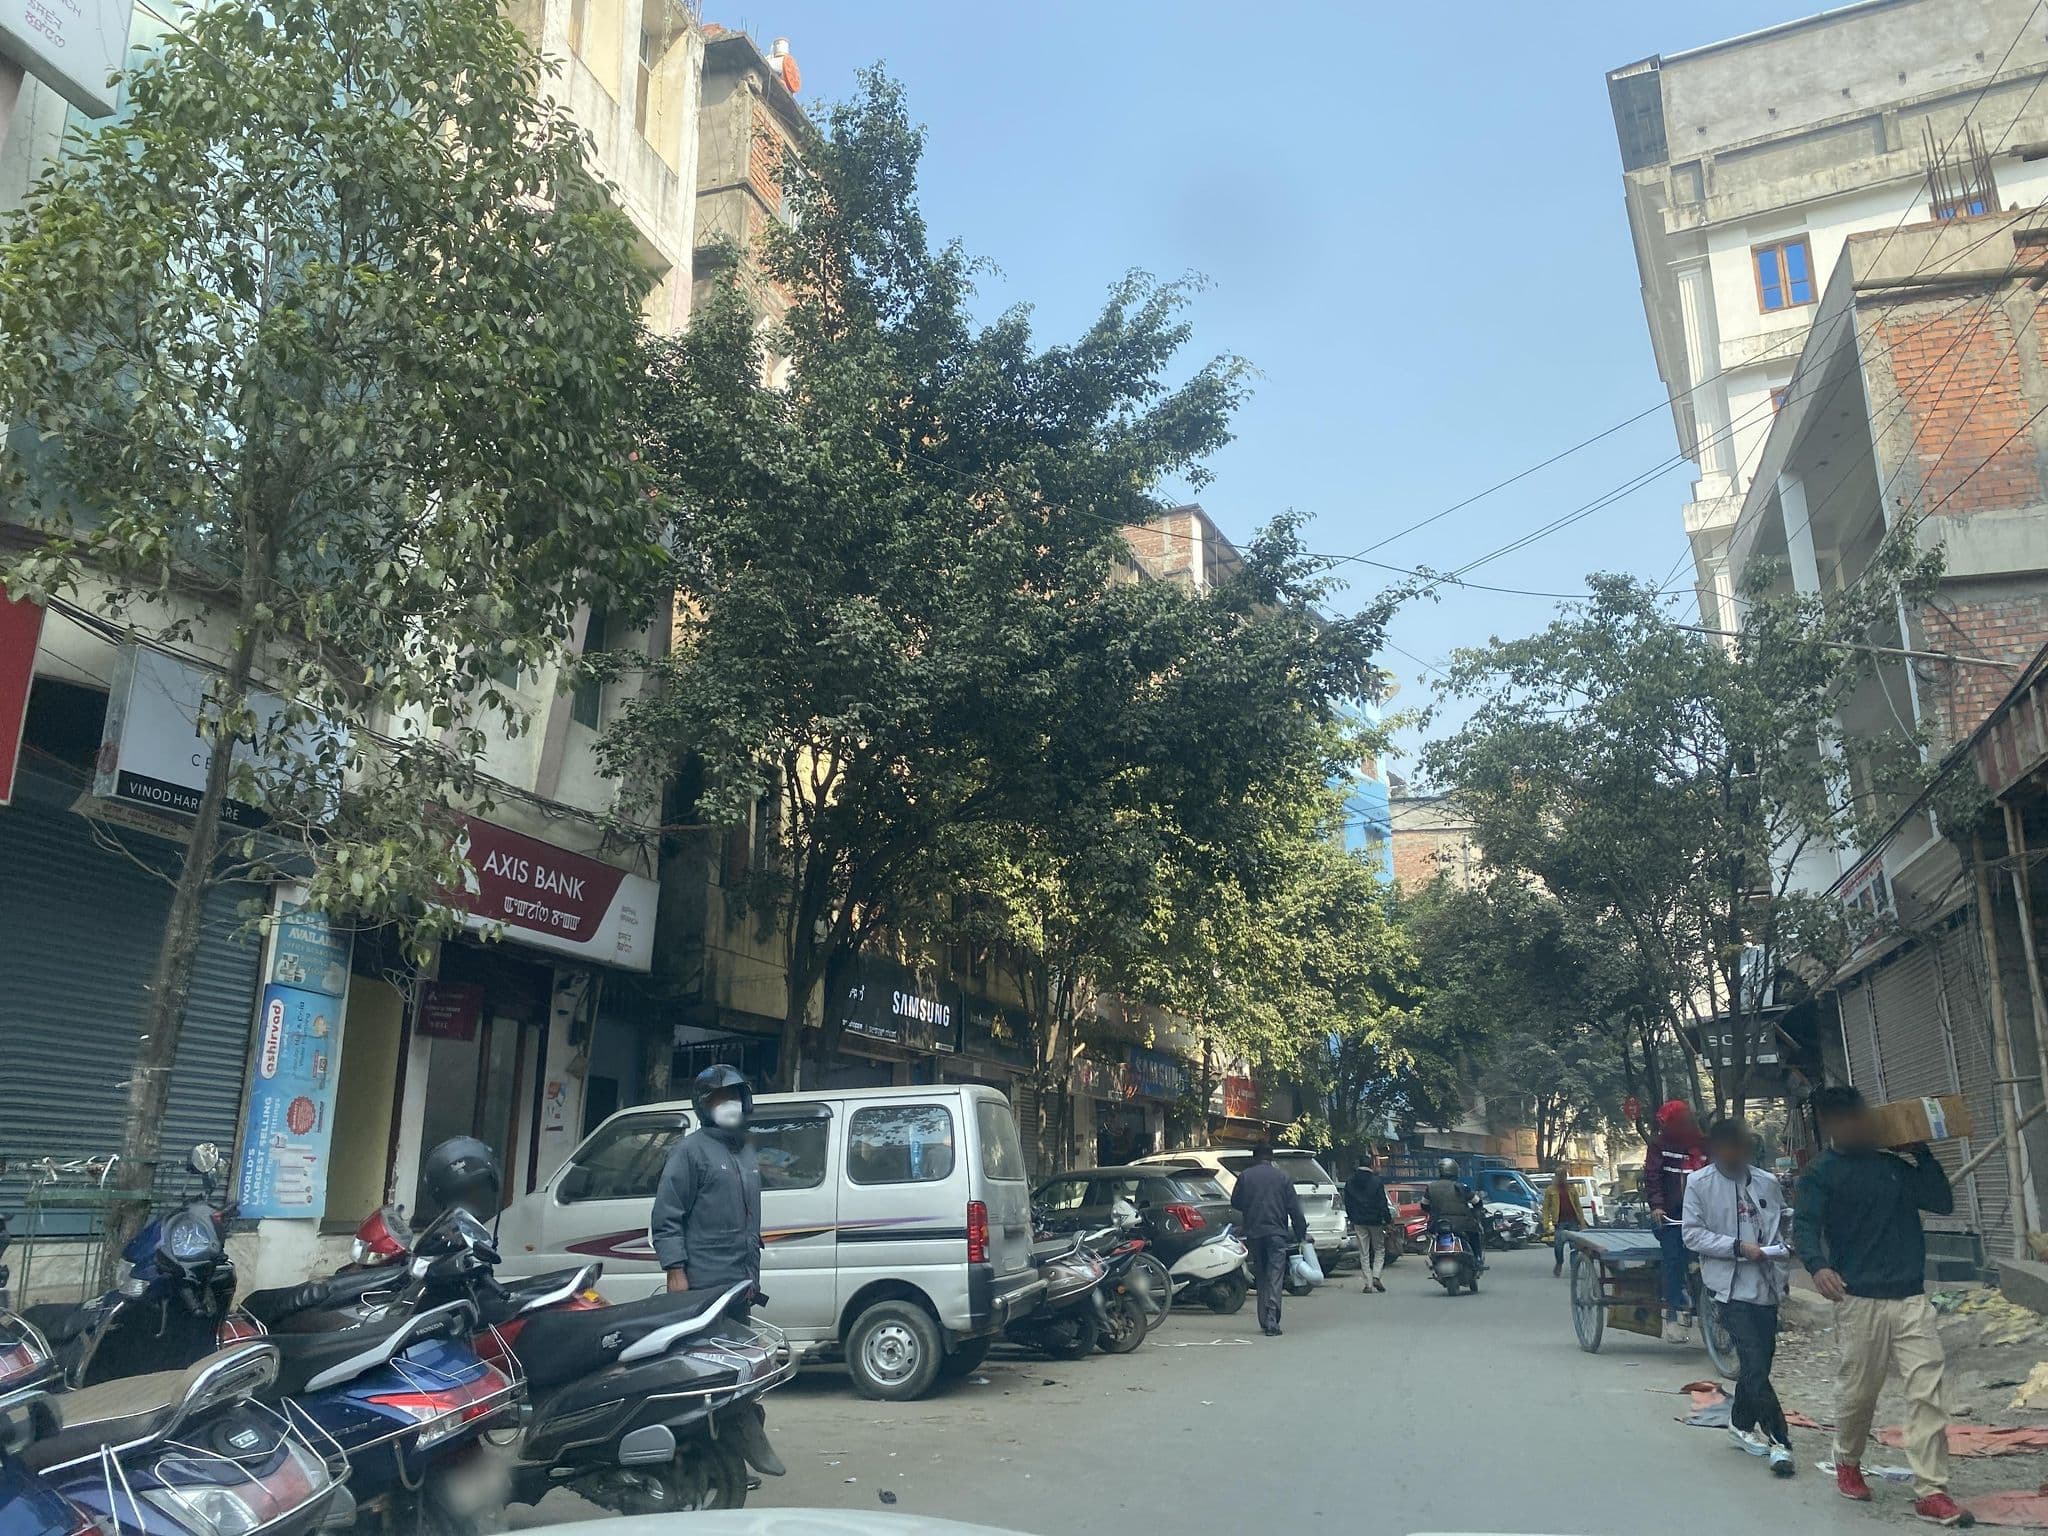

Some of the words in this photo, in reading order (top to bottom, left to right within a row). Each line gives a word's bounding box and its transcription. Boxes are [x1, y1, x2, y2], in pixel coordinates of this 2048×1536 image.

[129, 781, 172, 803] VINOD
[173, 793, 240, 821] HARARE
[482, 850, 529, 884] AXIS
[534, 864, 586, 901] BANK
[892, 990, 950, 1027] SAMSUNG
[265, 1003, 282, 1074] ashirvad
[252, 1149, 265, 1206] LARGEST
[259, 1096, 272, 1148] SELLING
[241, 1147, 256, 1207] WORLD'S
[415, 1322, 444, 1336] HONDA
